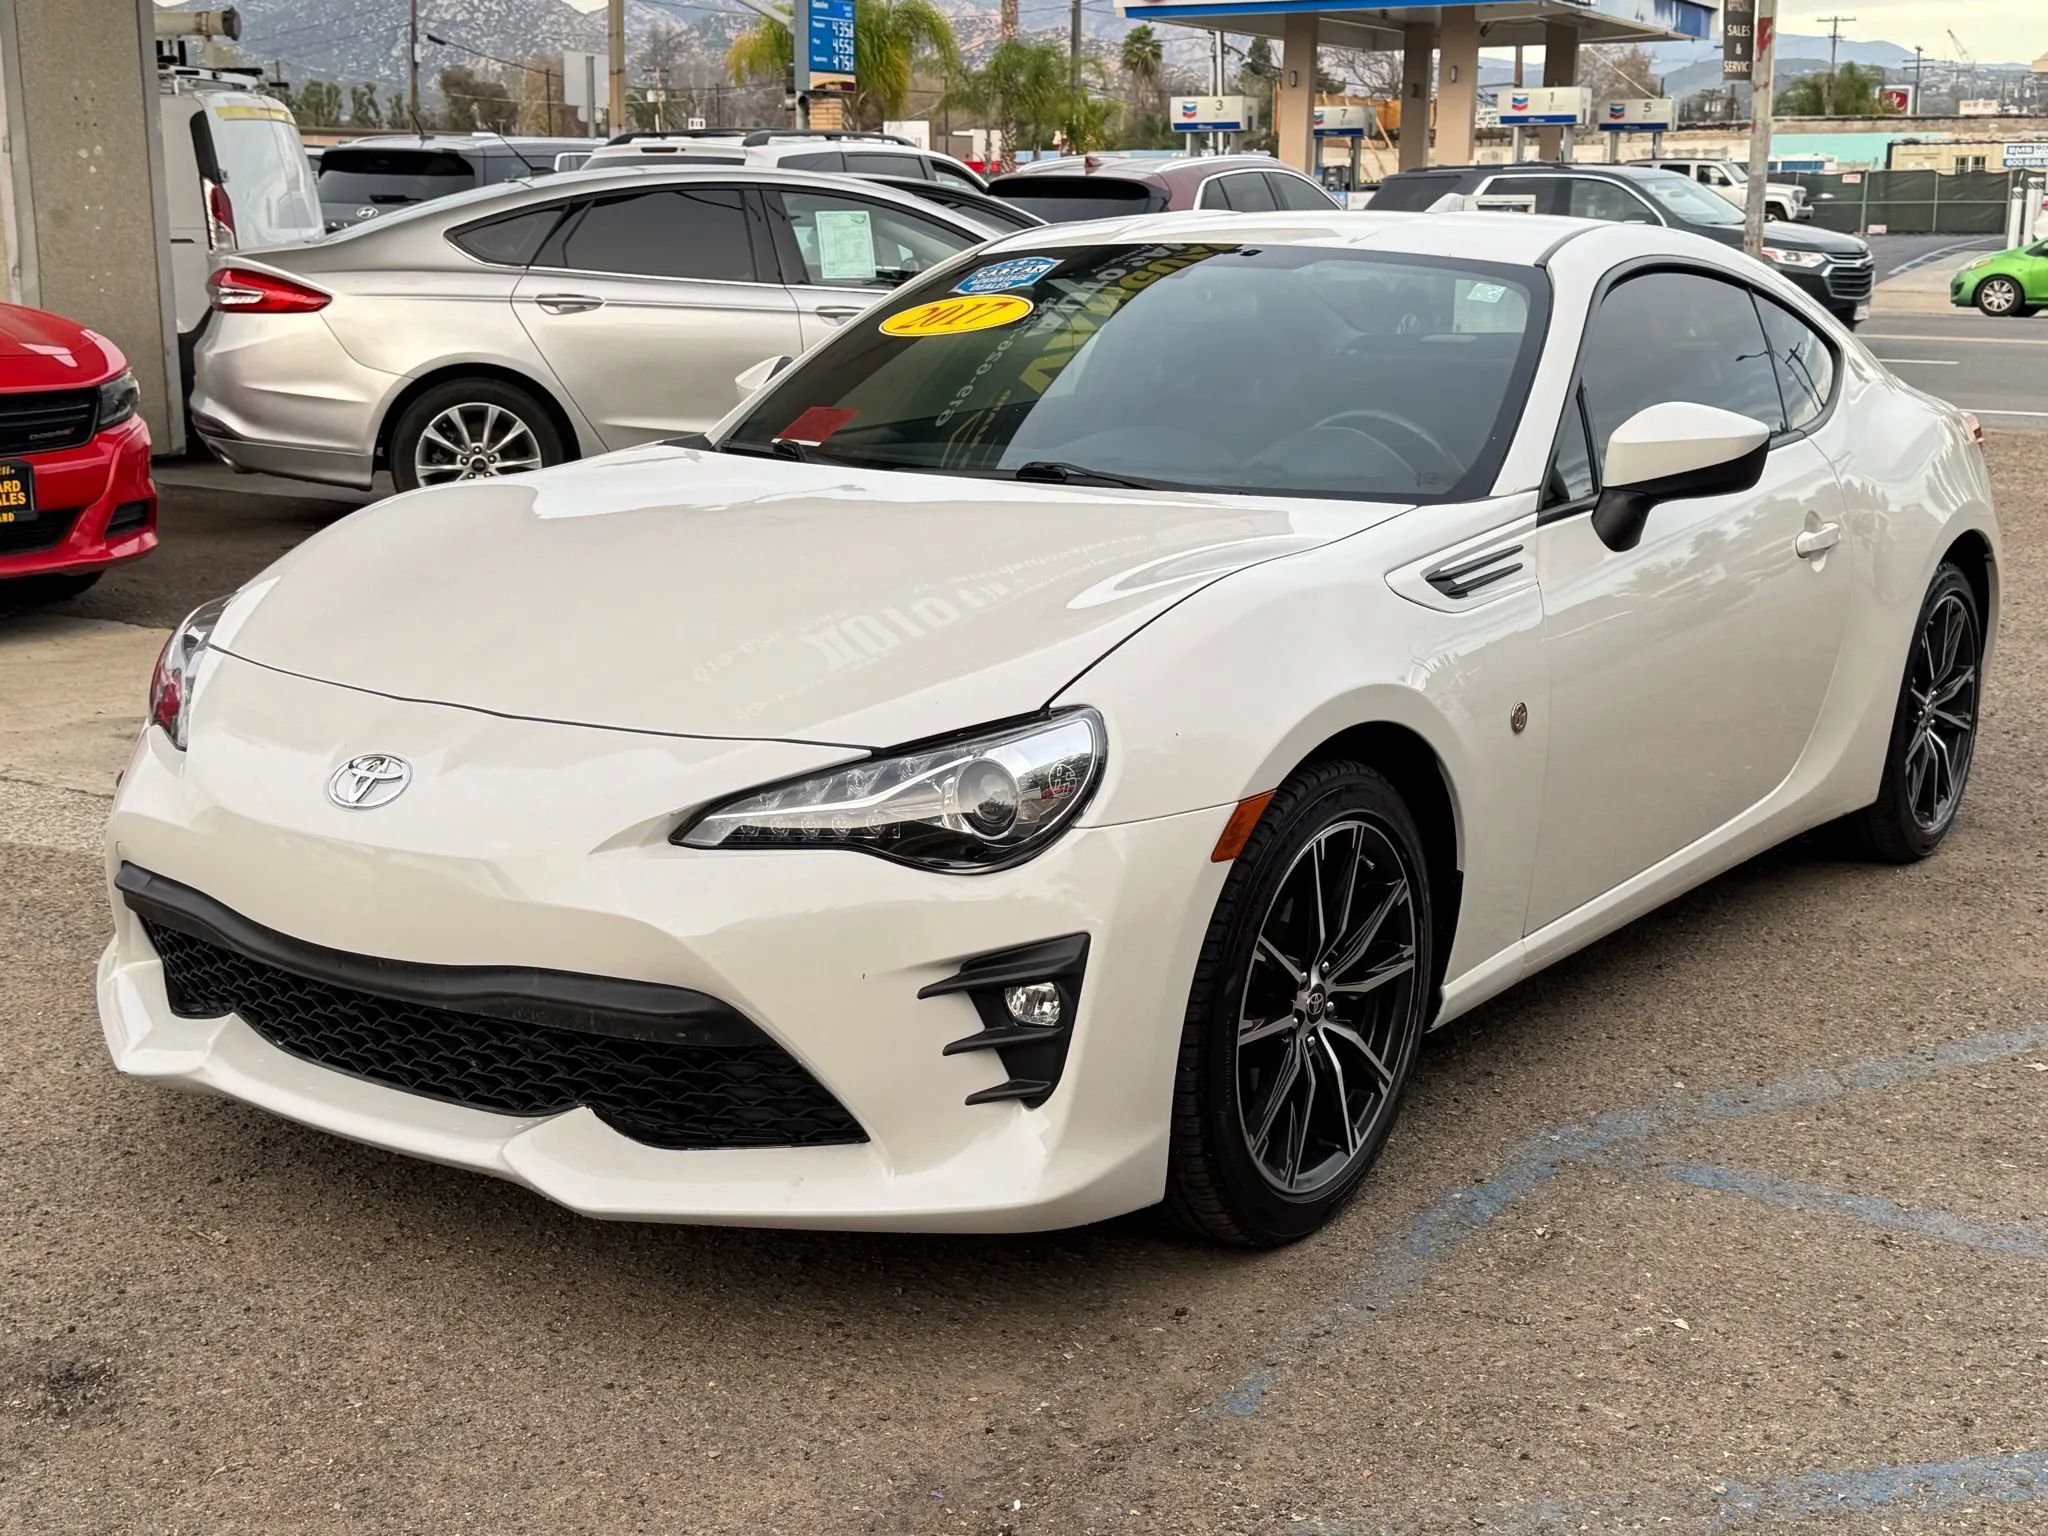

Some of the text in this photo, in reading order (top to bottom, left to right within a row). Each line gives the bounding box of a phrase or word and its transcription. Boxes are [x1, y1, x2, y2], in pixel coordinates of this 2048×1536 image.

[1727, 24, 1751, 37] SALES
[1735, 43, 1742, 55] &
[1724, 60, 1752, 73] SERVIC
[1215, 99, 1224, 111] 3
[1643, 102, 1652, 113] 5
[1340, 108, 1348, 119] 7
[892, 301, 1017, 331] 2017
